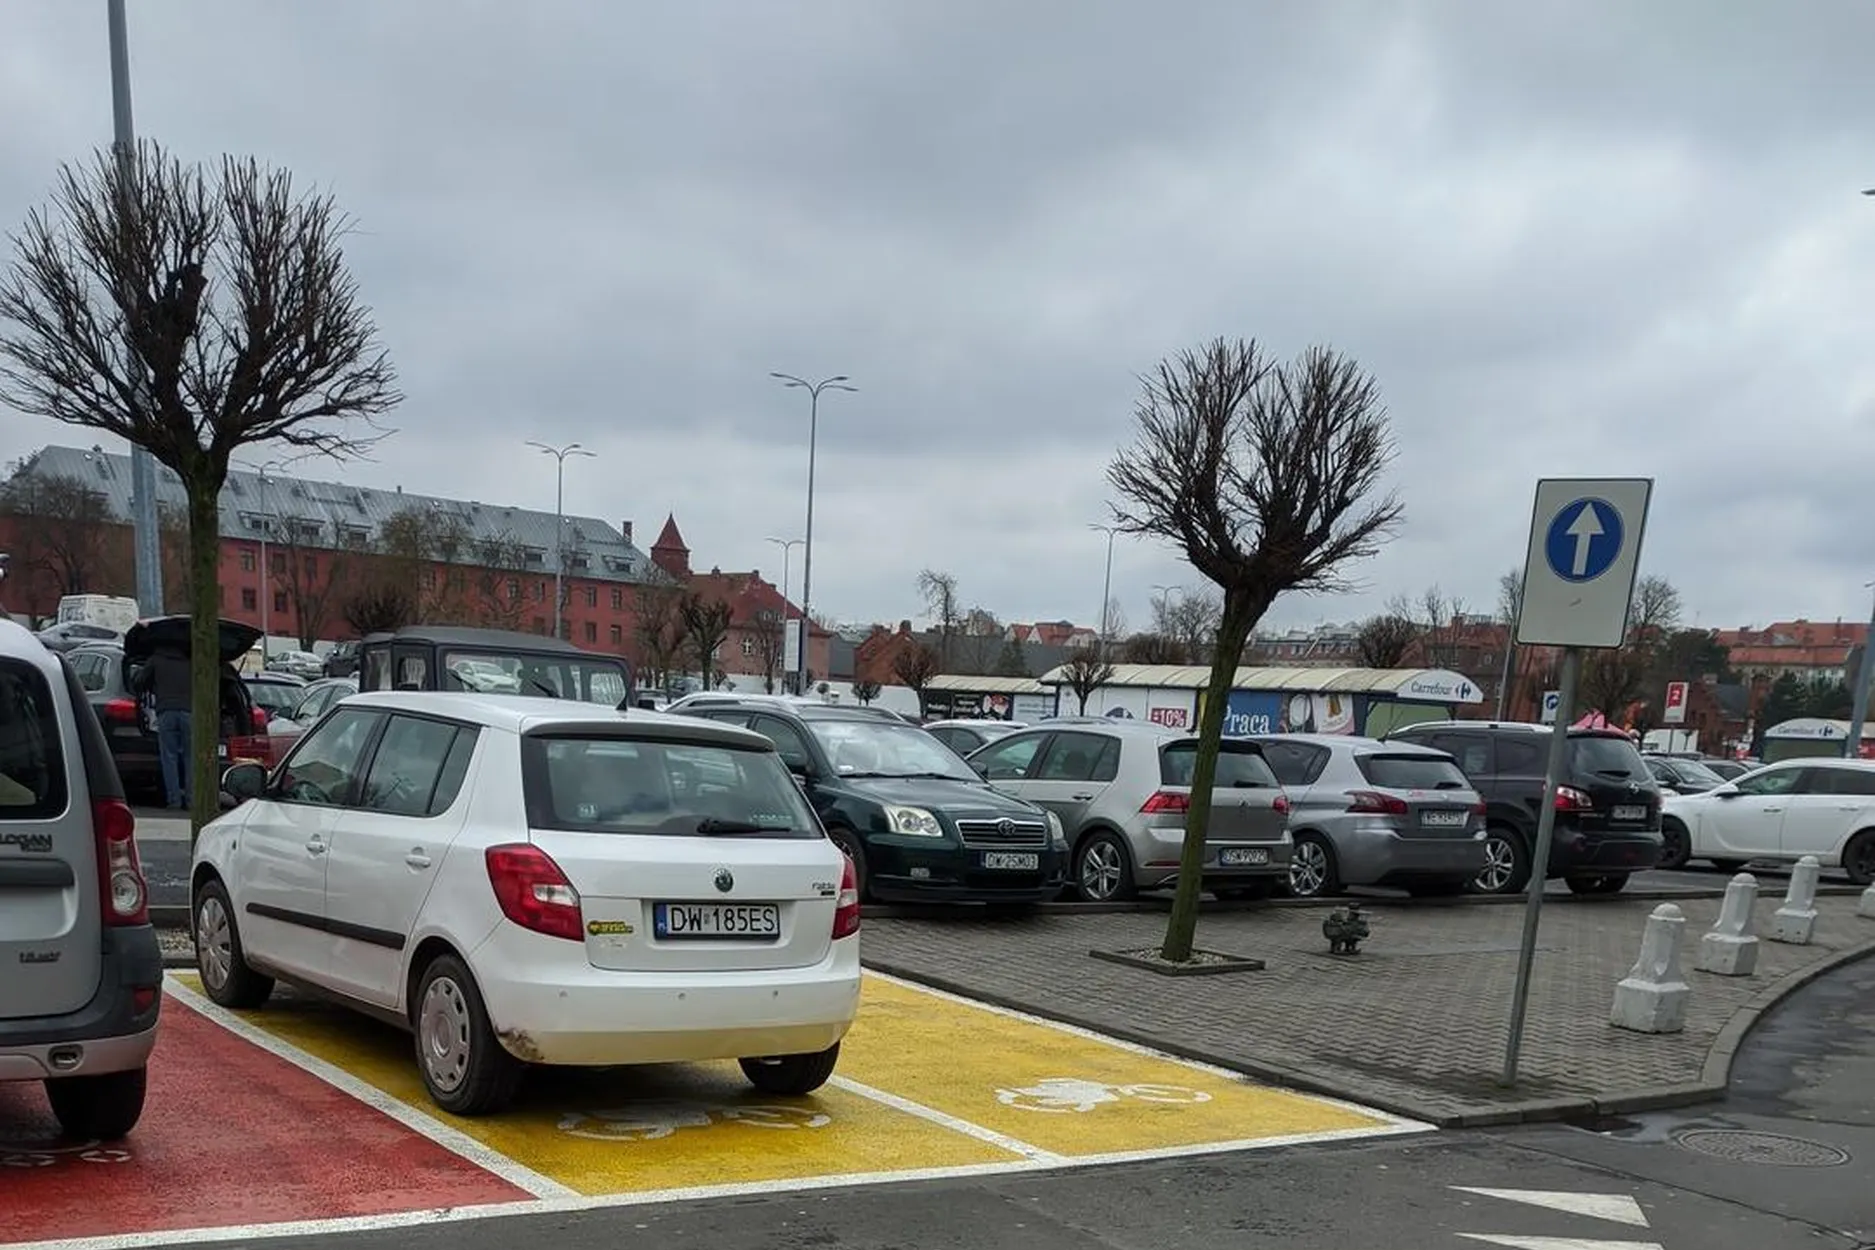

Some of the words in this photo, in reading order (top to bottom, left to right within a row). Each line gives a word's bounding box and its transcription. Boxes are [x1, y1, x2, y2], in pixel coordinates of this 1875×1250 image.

[1411, 681, 1453, 696] Carrefour
[671, 907, 702, 932] DW
[712, 907, 776, 932] 185ES
